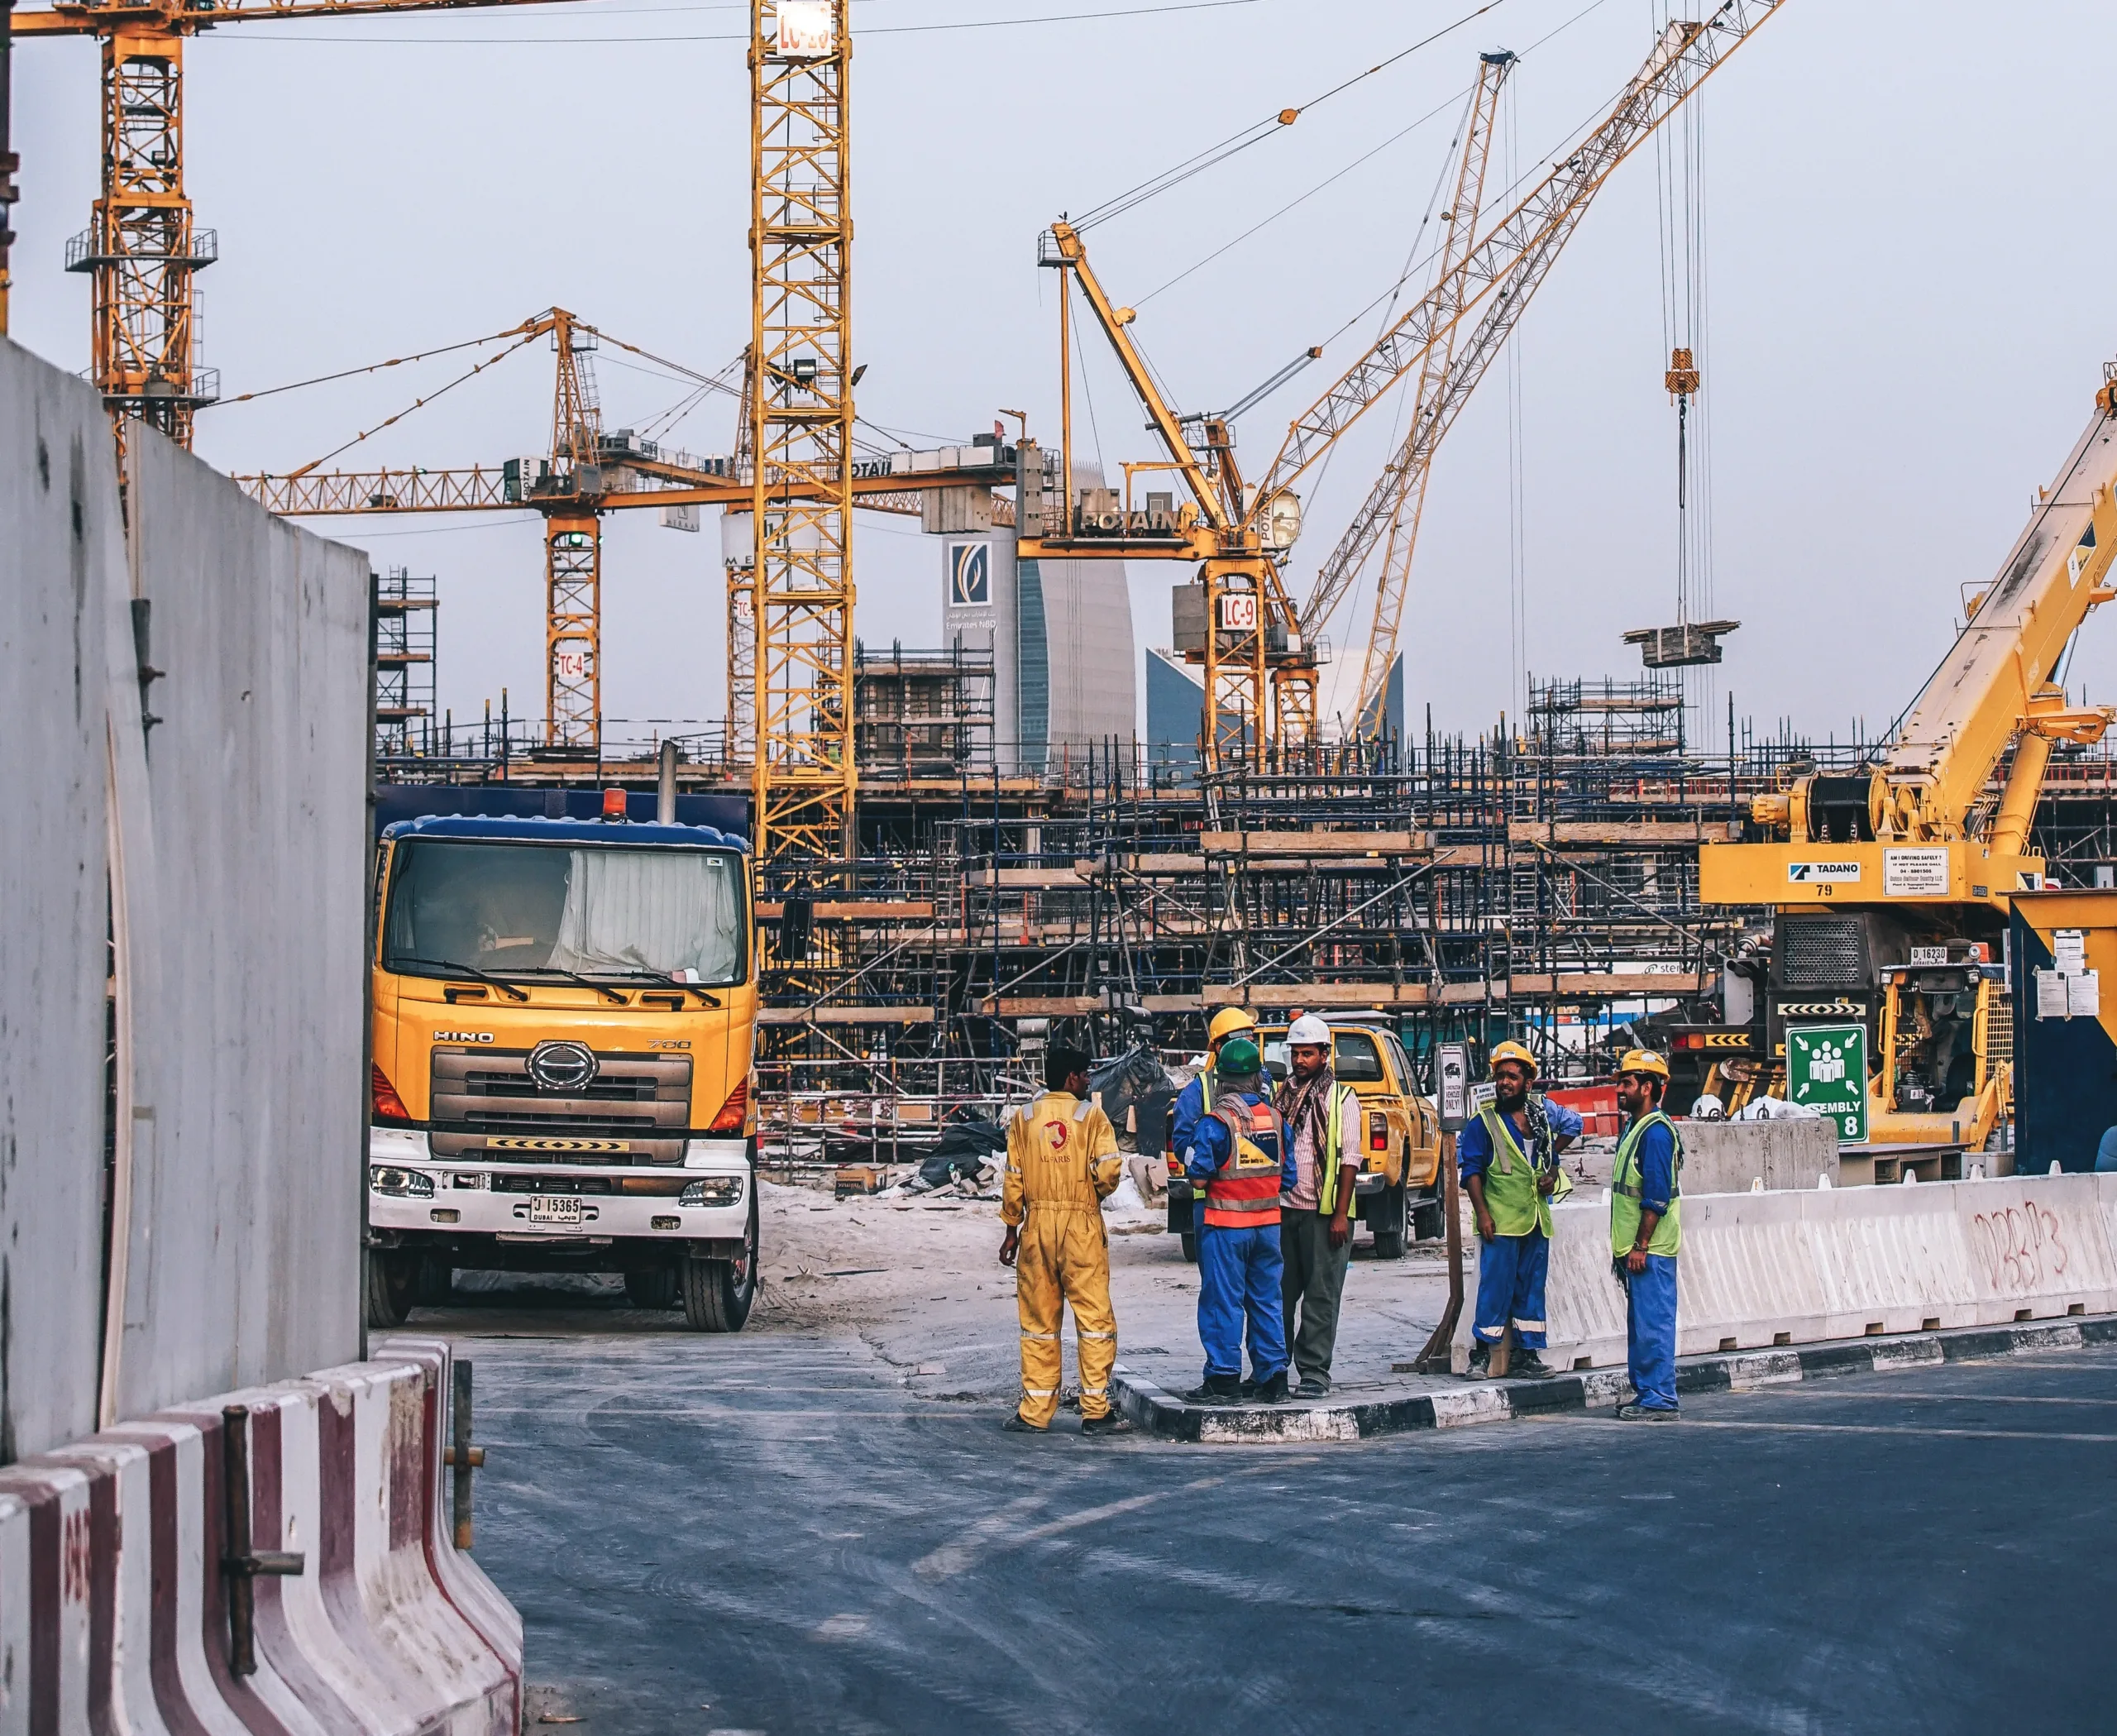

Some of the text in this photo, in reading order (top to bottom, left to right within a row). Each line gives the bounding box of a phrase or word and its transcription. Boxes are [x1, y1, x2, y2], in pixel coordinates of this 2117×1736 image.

[1080, 511, 1179, 530] POTAIN
[1225, 599, 1254, 626] LC-9
[946, 619, 996, 629] Emirates NBD
[560, 655, 583, 675] TC-4
[1817, 863, 1858, 873] TADANO
[1816, 884, 1833, 897] 79
[1914, 949, 1945, 959] D 16230
[432, 1031, 494, 1044] HINO
[647, 1039, 691, 1050] 700
[1844, 1116, 1858, 1136] 8
[535, 1199, 579, 1212] J 15365
